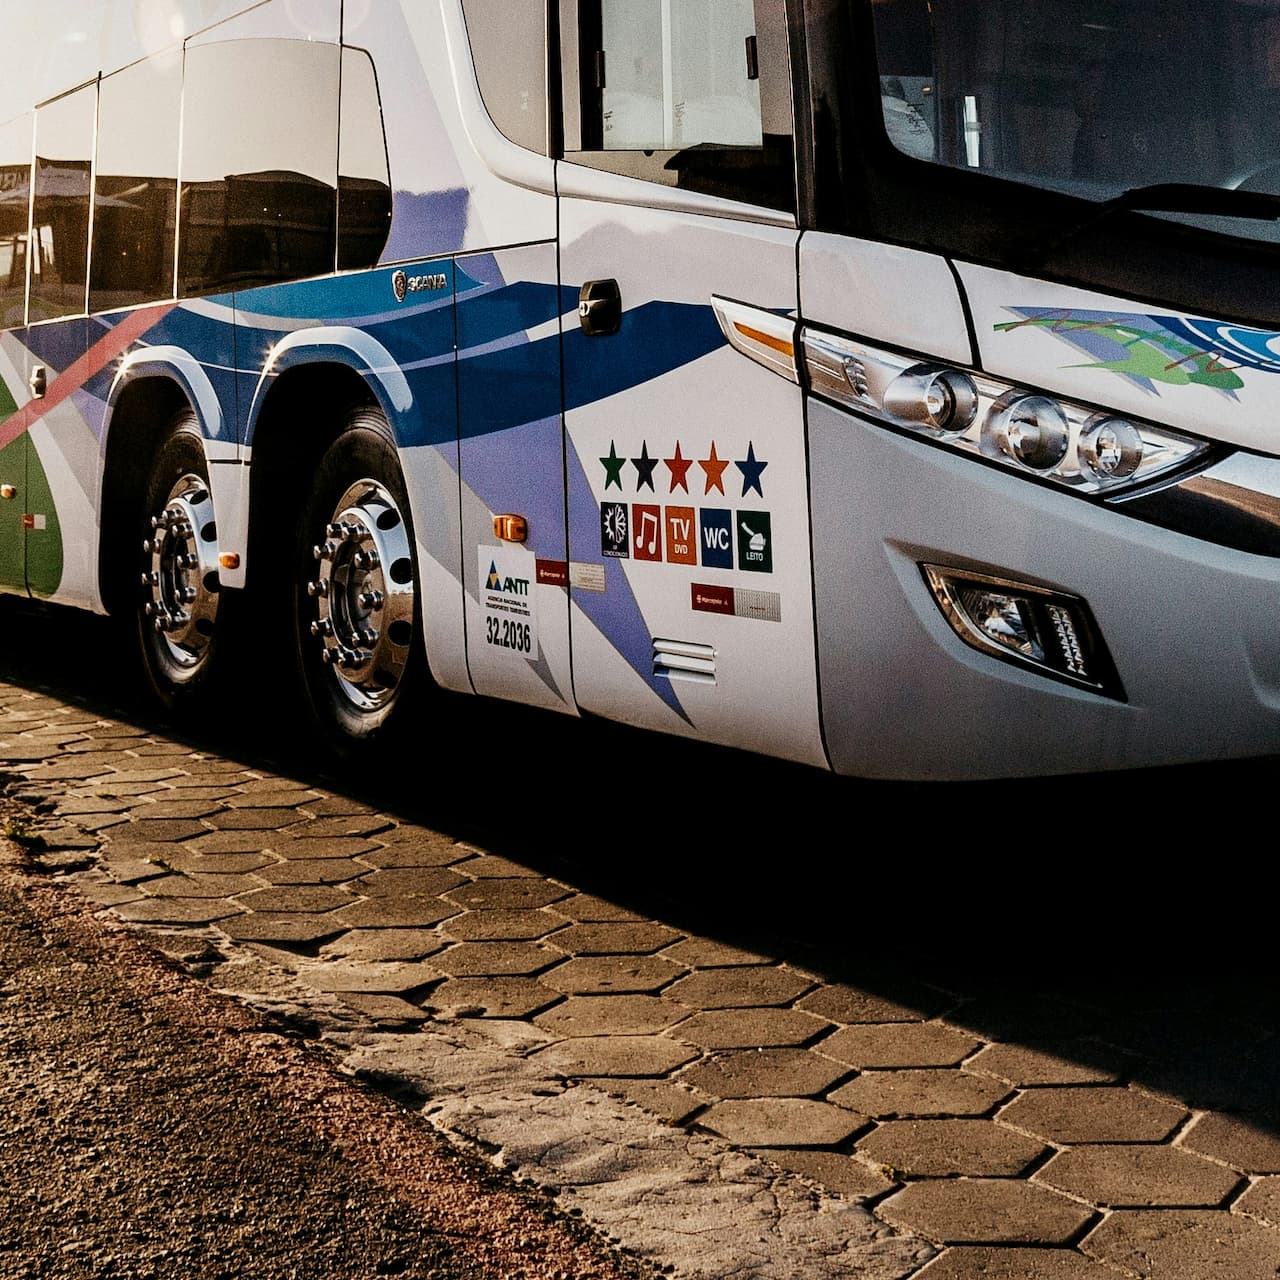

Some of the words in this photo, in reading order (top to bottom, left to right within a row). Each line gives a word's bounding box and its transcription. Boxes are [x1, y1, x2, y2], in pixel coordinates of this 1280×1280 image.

[407, 273, 448, 291] SCANIA
[670, 518, 690, 541] TV
[704, 527, 729, 550] WC
[674, 544, 688, 555] DVD
[746, 552, 764, 561] LEITO
[502, 576, 530, 596] ANTT
[486, 616, 531, 653] 32.2036
